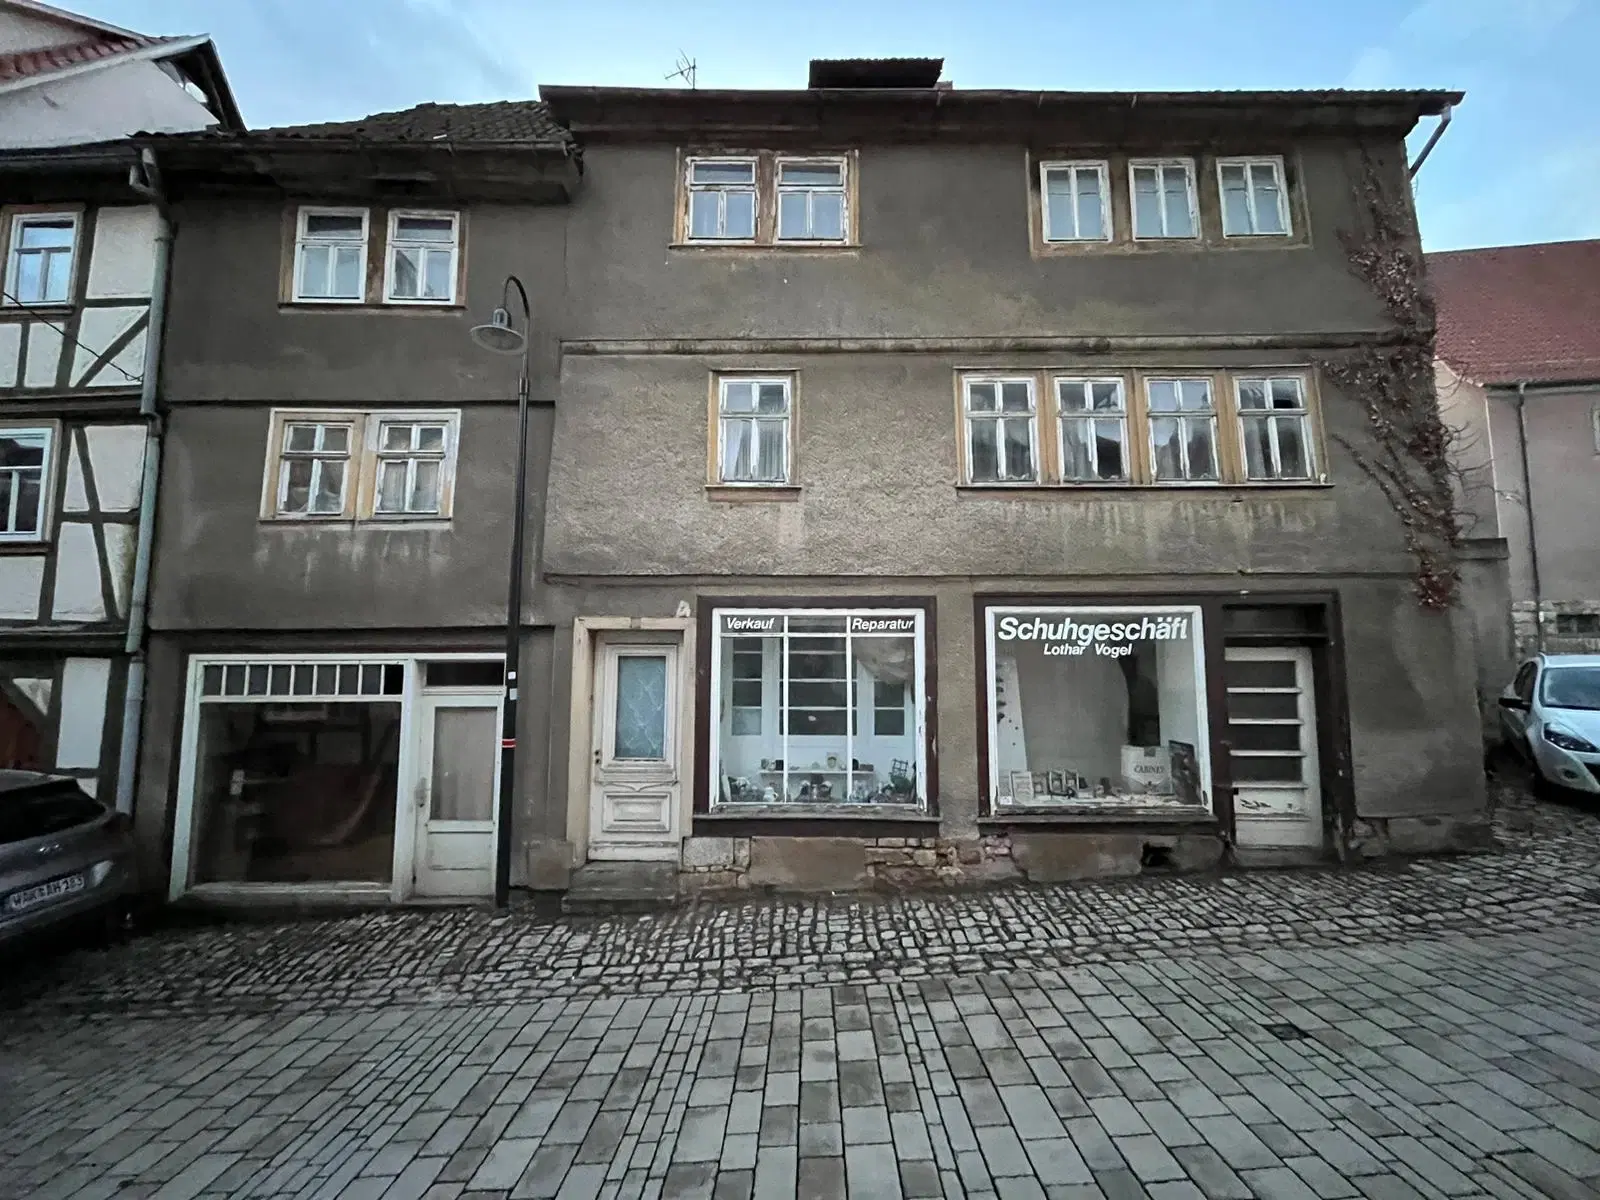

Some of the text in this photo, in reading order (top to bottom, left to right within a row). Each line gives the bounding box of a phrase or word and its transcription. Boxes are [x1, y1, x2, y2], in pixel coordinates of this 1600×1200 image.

[726, 617, 775, 630] Verkauf
[852, 618, 914, 631] Reparatur
[998, 616, 1188, 646] Schuhgeschäft
[1043, 643, 1133, 658] Lothar Vogel
